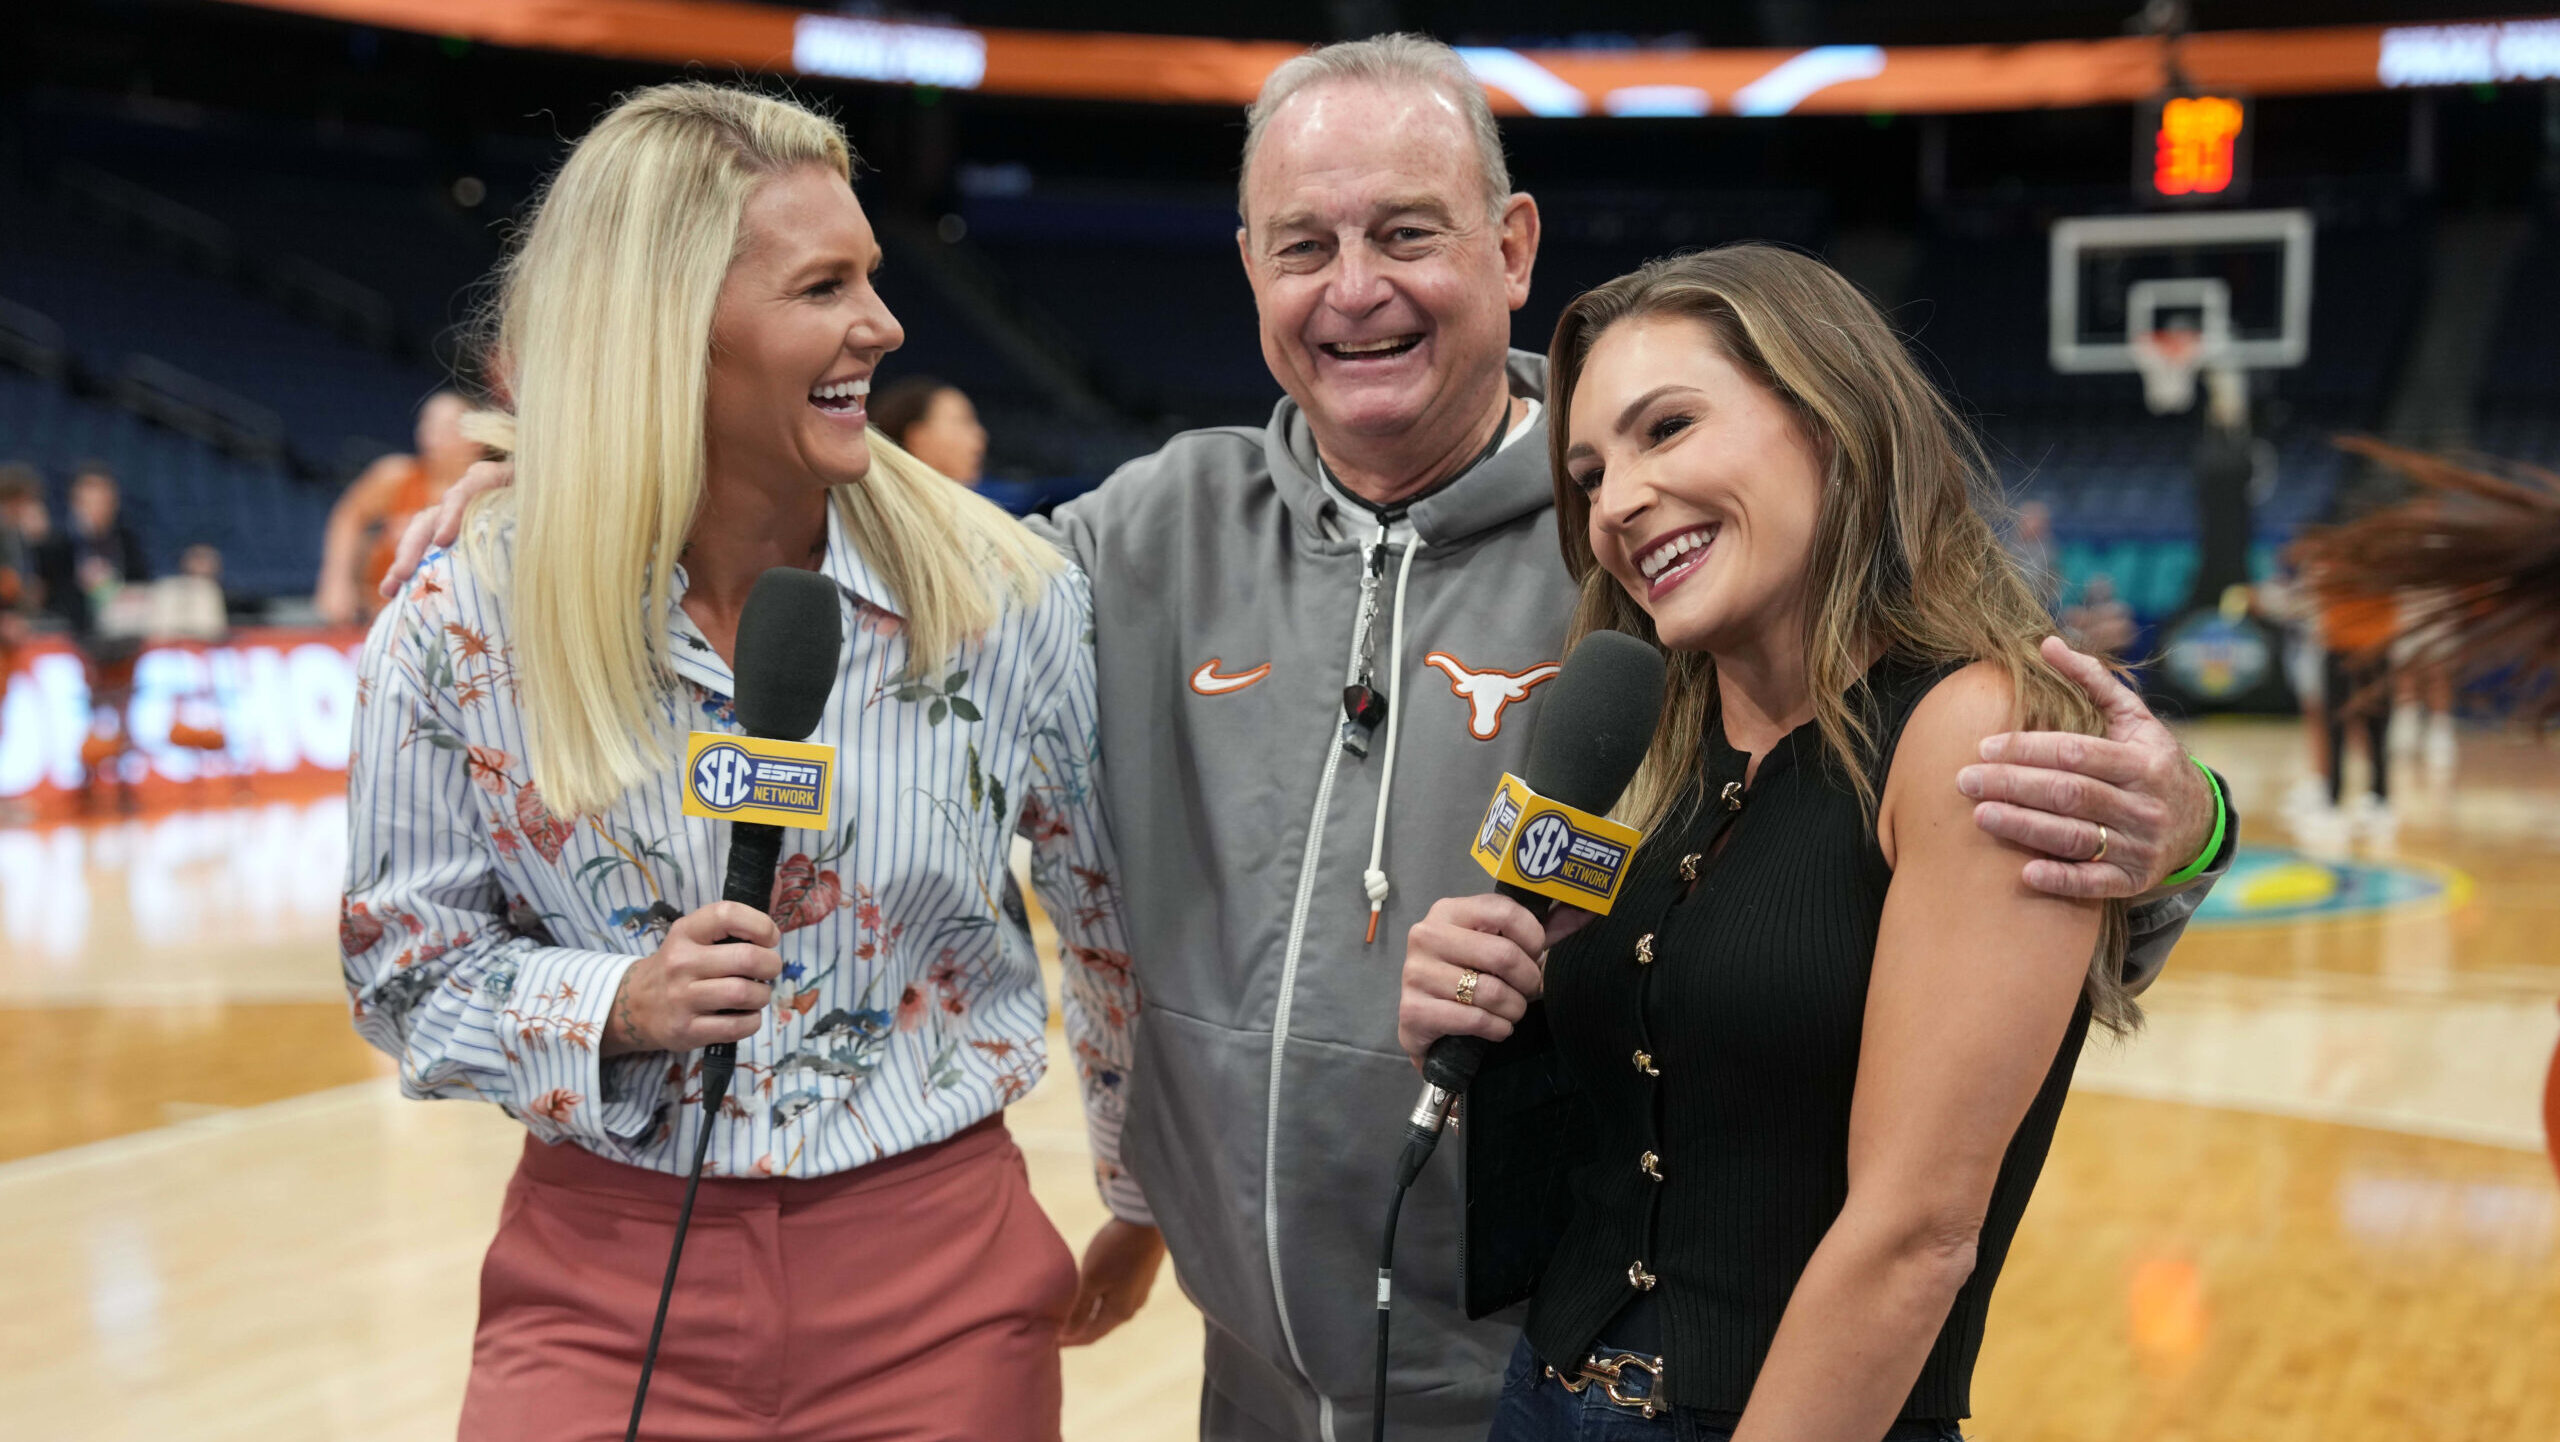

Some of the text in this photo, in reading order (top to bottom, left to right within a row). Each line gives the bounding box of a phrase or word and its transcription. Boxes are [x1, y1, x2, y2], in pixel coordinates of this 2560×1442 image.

[697, 748, 752, 806] SEC
[755, 762, 818, 785] ESPN
[753, 785, 816, 807] NETWORK
[1519, 816, 1569, 877] SEC
[1569, 837, 1621, 868] ESPN
[1560, 860, 1612, 891] NETWORK
